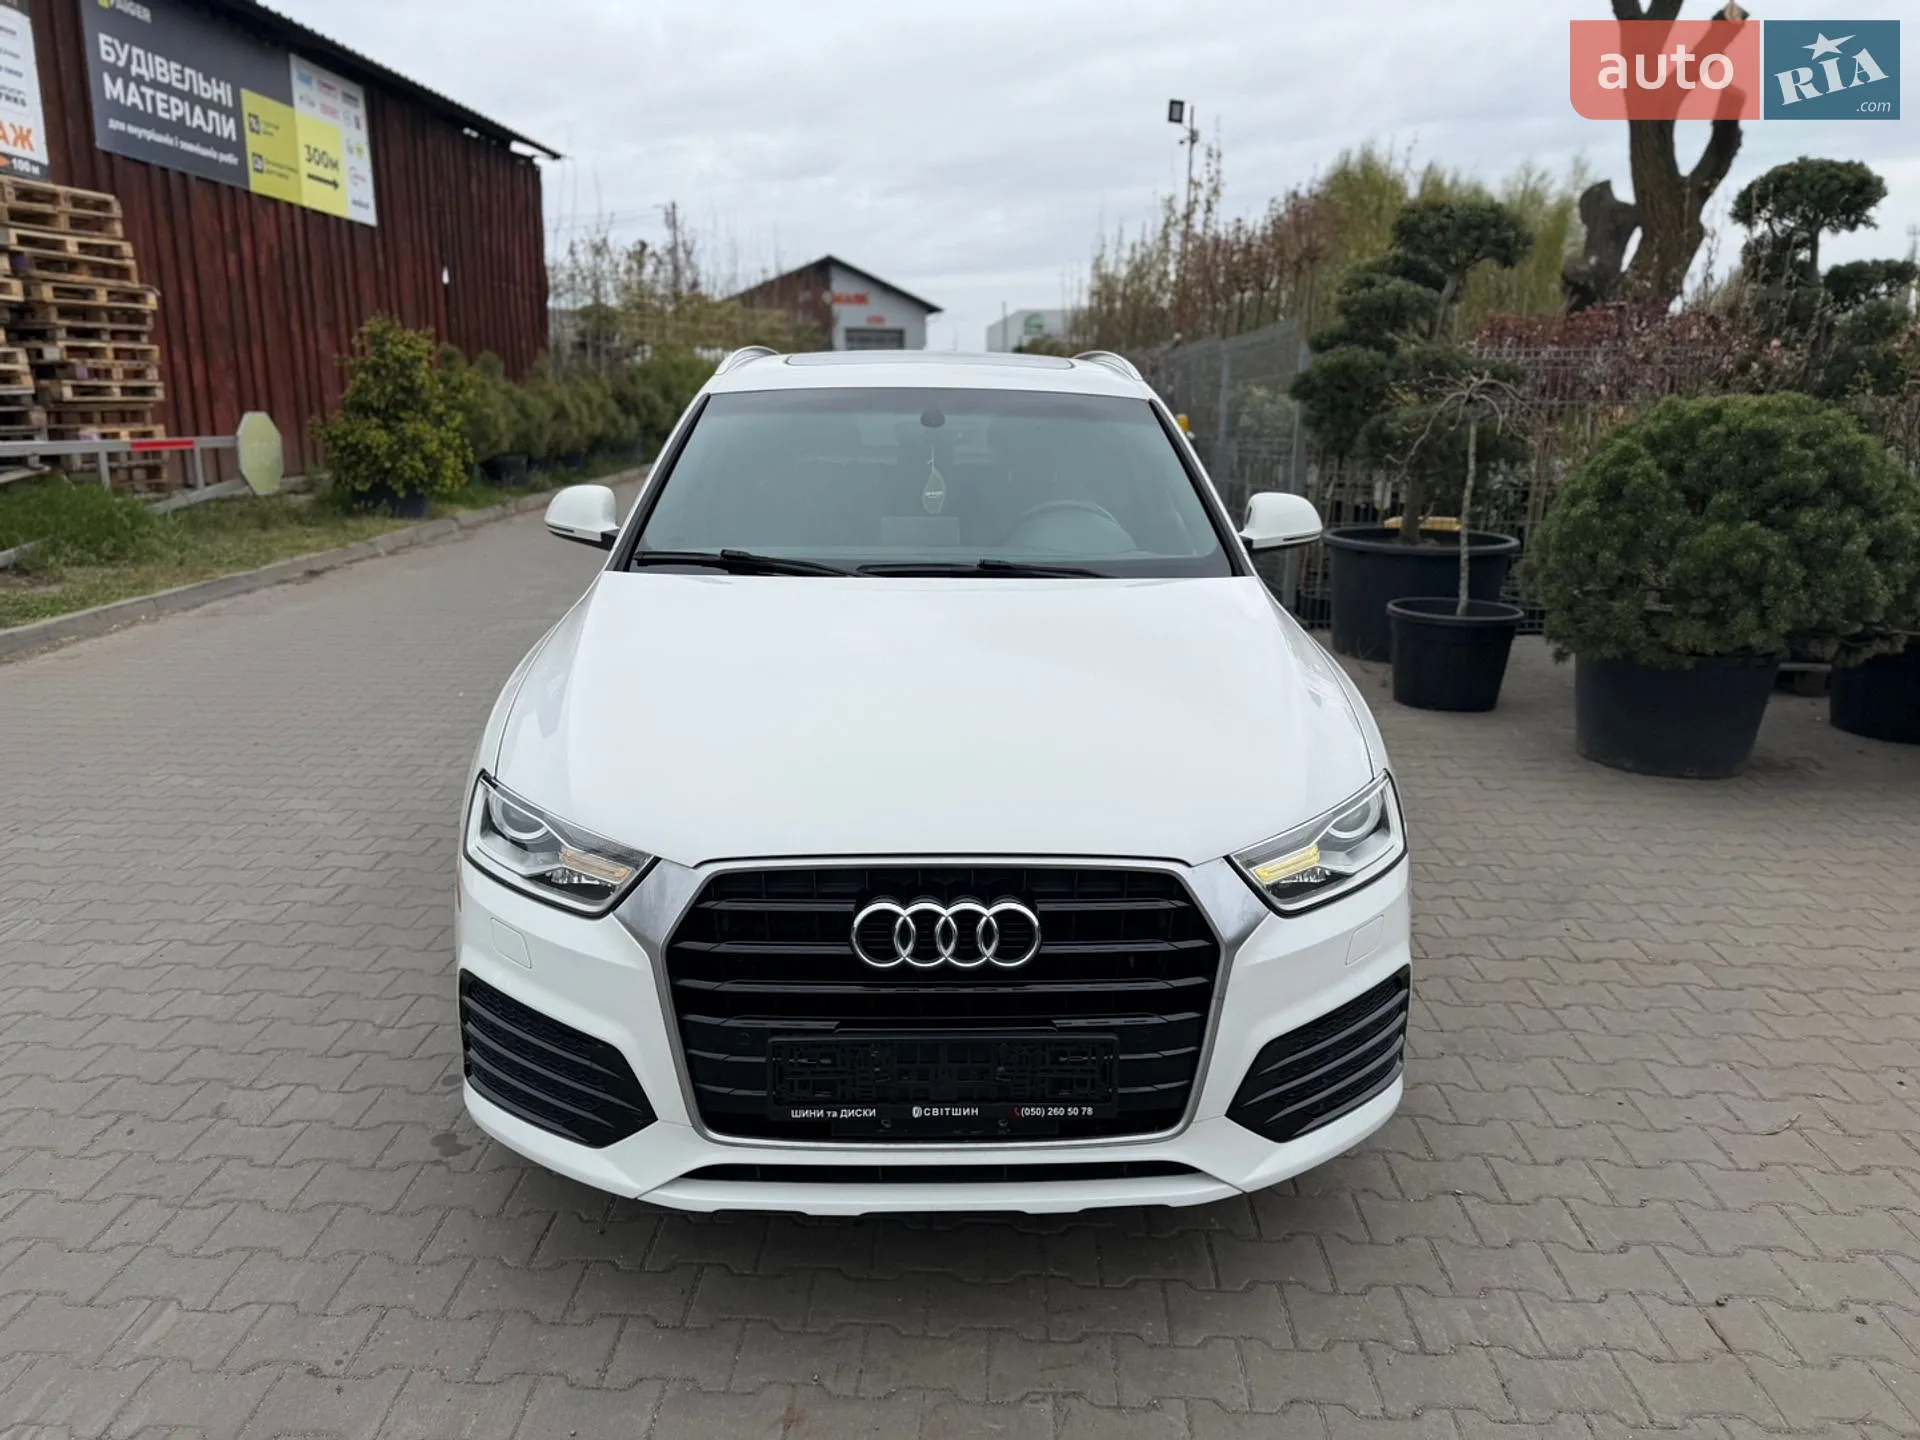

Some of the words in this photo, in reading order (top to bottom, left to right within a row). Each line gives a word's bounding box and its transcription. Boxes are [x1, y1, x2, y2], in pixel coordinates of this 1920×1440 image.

[98, 32, 233, 108] БУДІВЕЛЬНІ
[103, 71, 237, 142] МАТЕРІАЛИ
[791, 1109, 824, 1118] ШИНИ
[826, 1110, 838, 1118] та
[840, 1108, 876, 1119] ДИСКИ
[923, 1107, 979, 1116] СВІТШИН
[1021, 1106, 1045, 1117] (050)
[1047, 1107, 1065, 1116] 260
[1067, 1107, 1079, 1116] 50
[1081, 1106, 1093, 1116] 78
